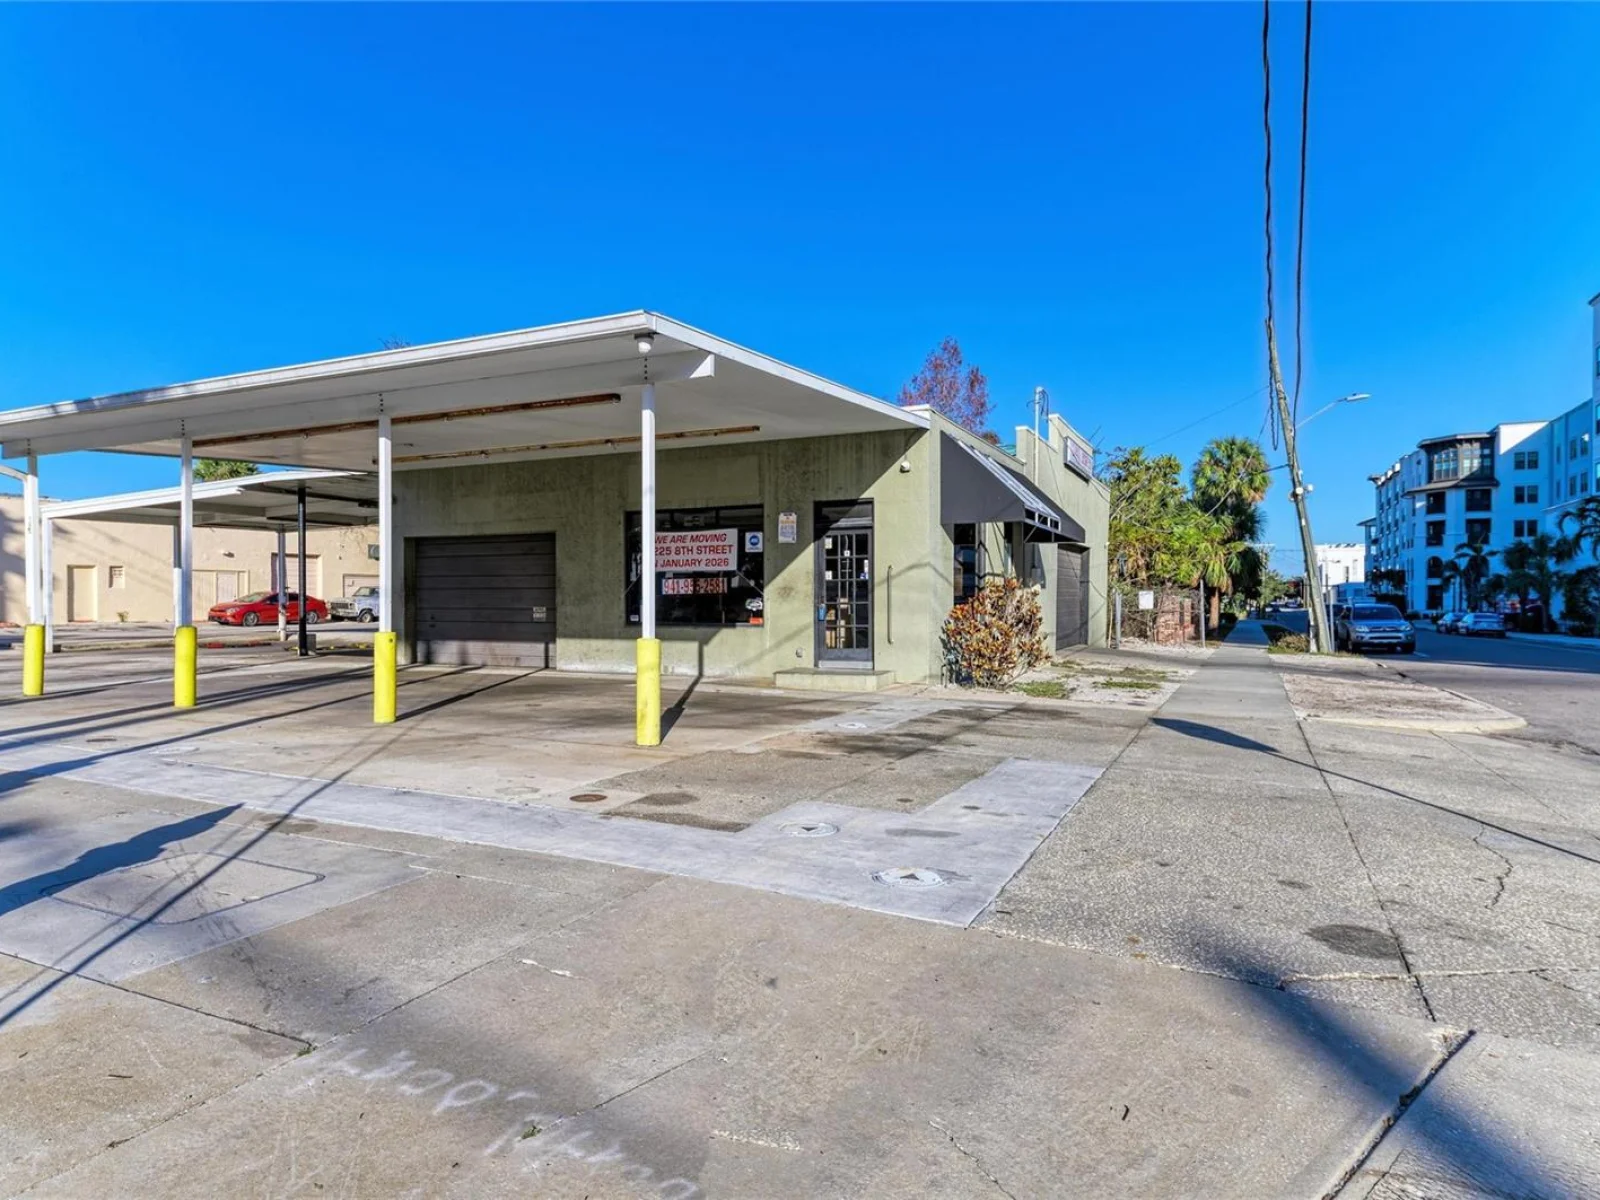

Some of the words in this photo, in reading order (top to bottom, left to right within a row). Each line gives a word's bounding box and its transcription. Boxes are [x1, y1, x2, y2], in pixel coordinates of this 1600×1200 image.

[655, 535, 668, 544] WE
[669, 534, 687, 544] ARE
[690, 533, 727, 543] MOVING
[674, 545, 694, 556] 8TH
[696, 544, 734, 555] STREET
[661, 558, 702, 568] JANUARY
[705, 557, 729, 567] 2026
